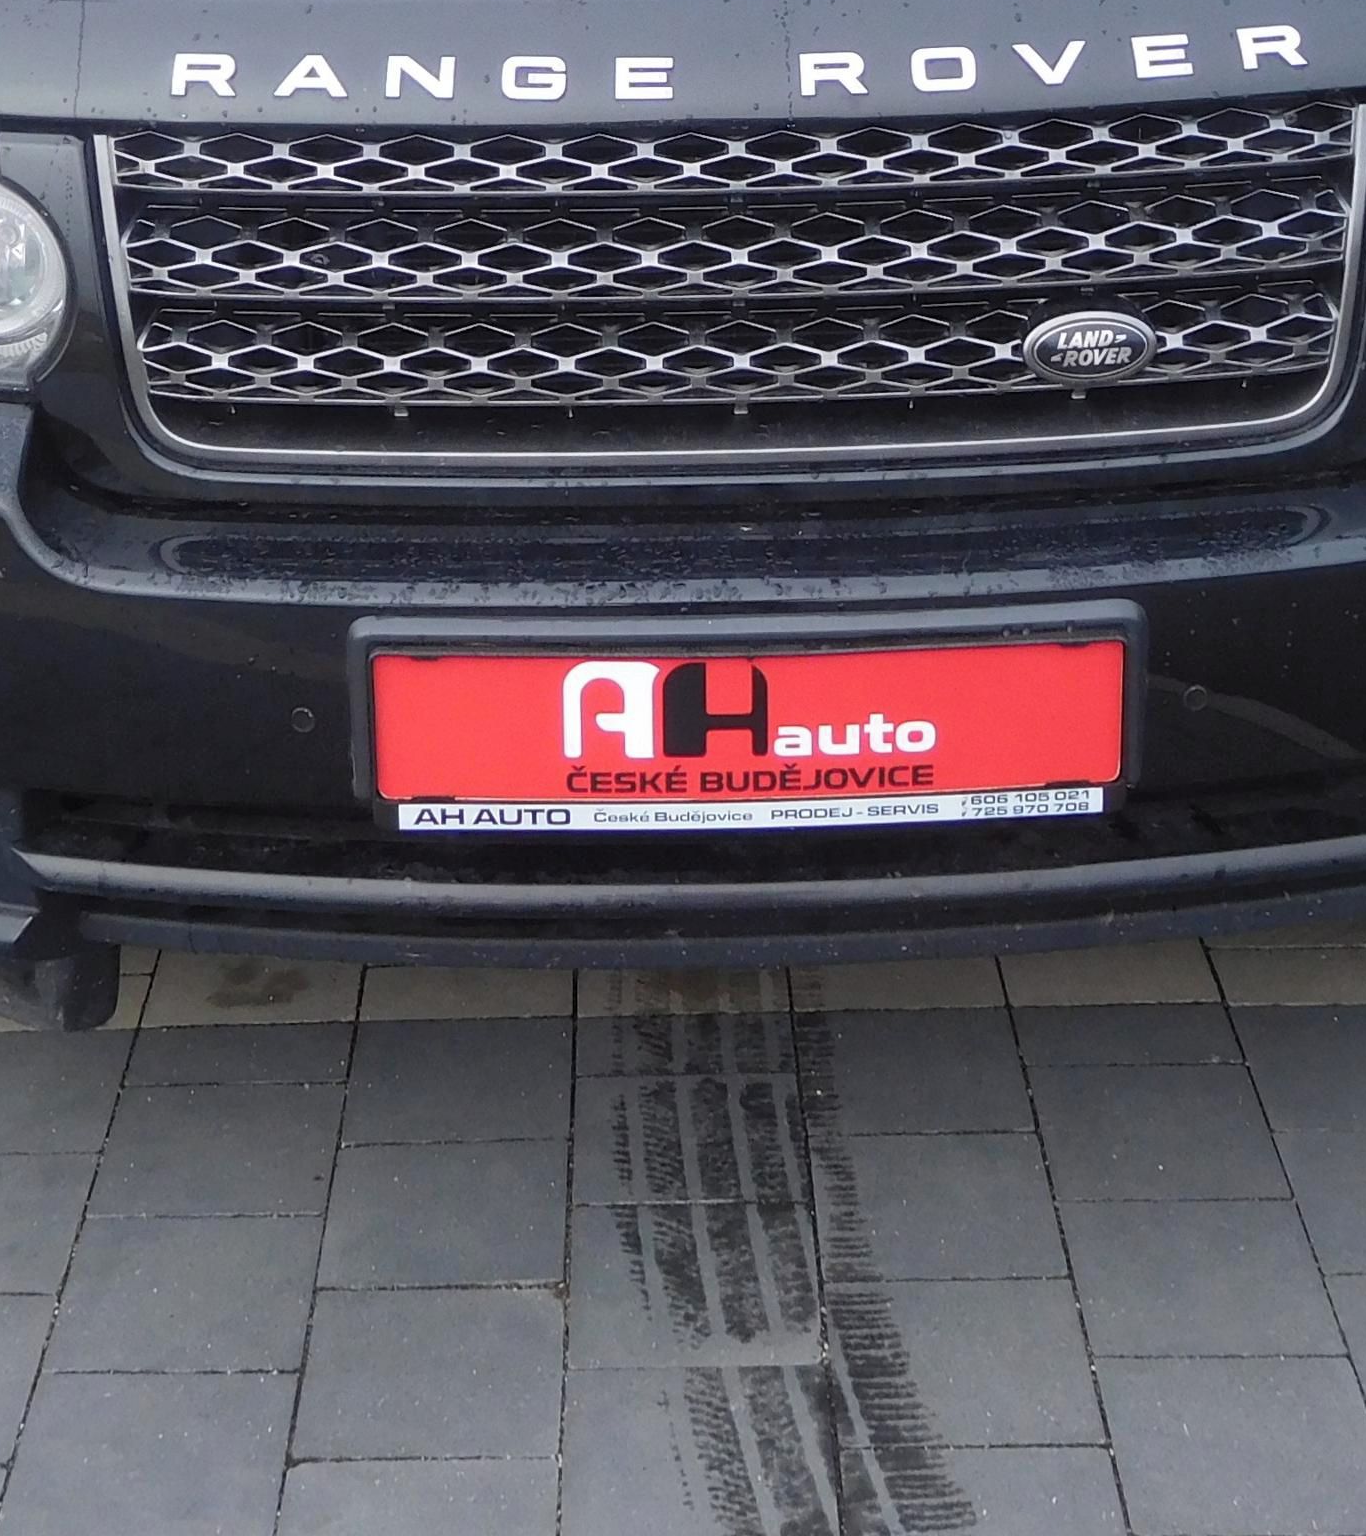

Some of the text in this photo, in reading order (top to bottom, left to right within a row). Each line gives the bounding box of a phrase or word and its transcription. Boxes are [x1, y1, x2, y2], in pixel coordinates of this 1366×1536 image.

[170, 24, 1310, 101] RANGE ROVER
[1056, 329, 1114, 350] LAND
[1061, 346, 1133, 367] ROVER
[566, 763, 934, 794] ČESKÉ BUDĚJOVICE
[971, 790, 1090, 805] 606 105 021
[413, 808, 465, 826] AH
[472, 808, 572, 826] AUTO
[593, 807, 650, 824] České
[654, 809, 754, 824] Budějovice
[972, 801, 1089, 817] 725 970 708
